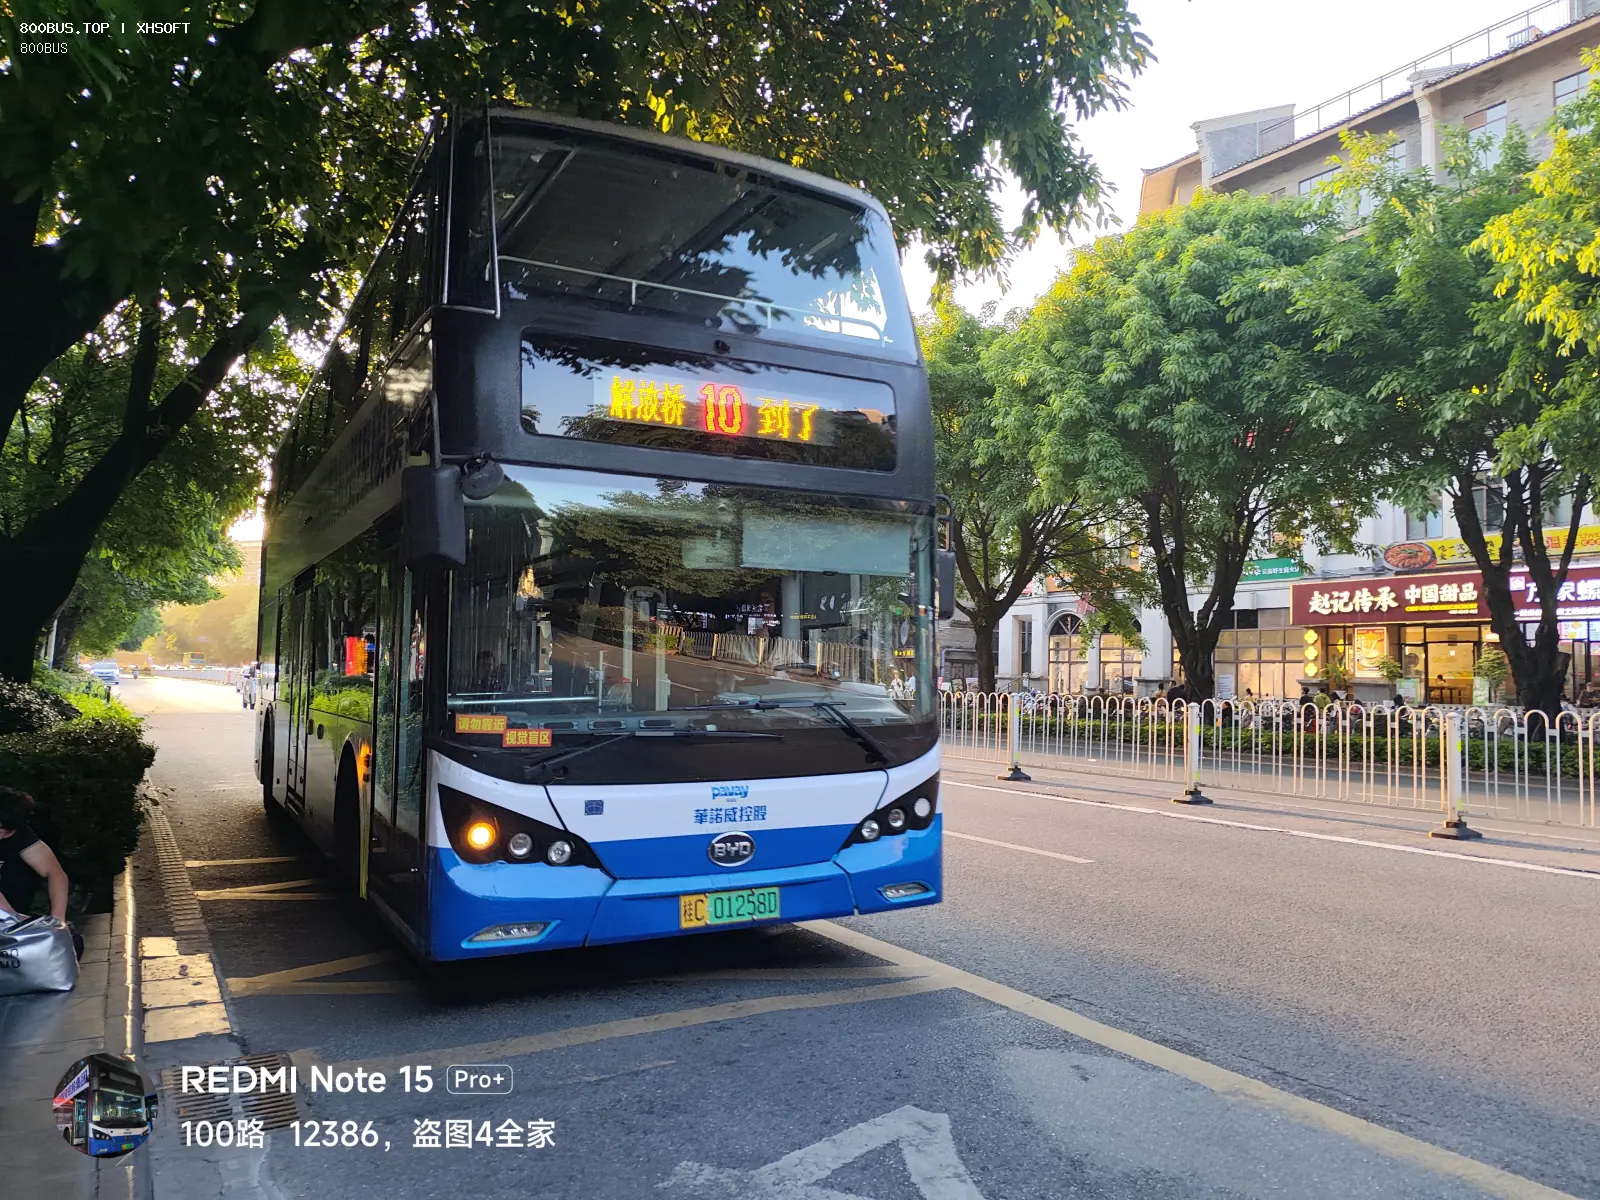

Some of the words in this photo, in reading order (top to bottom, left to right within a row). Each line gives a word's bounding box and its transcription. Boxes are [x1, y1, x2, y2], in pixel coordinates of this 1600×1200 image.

[610, 375, 687, 427] 解放桥
[700, 383, 743, 435] 10
[757, 397, 819, 441] 到了
[1309, 586, 1399, 615] 赵记传承
[1404, 582, 1478, 604] 中国甜品
[458, 717, 506, 731] 请勿靠近
[505, 731, 551, 745] 视觉盲区
[694, 805, 767, 825] 華諾威控股
[714, 841, 751, 858] BYD
